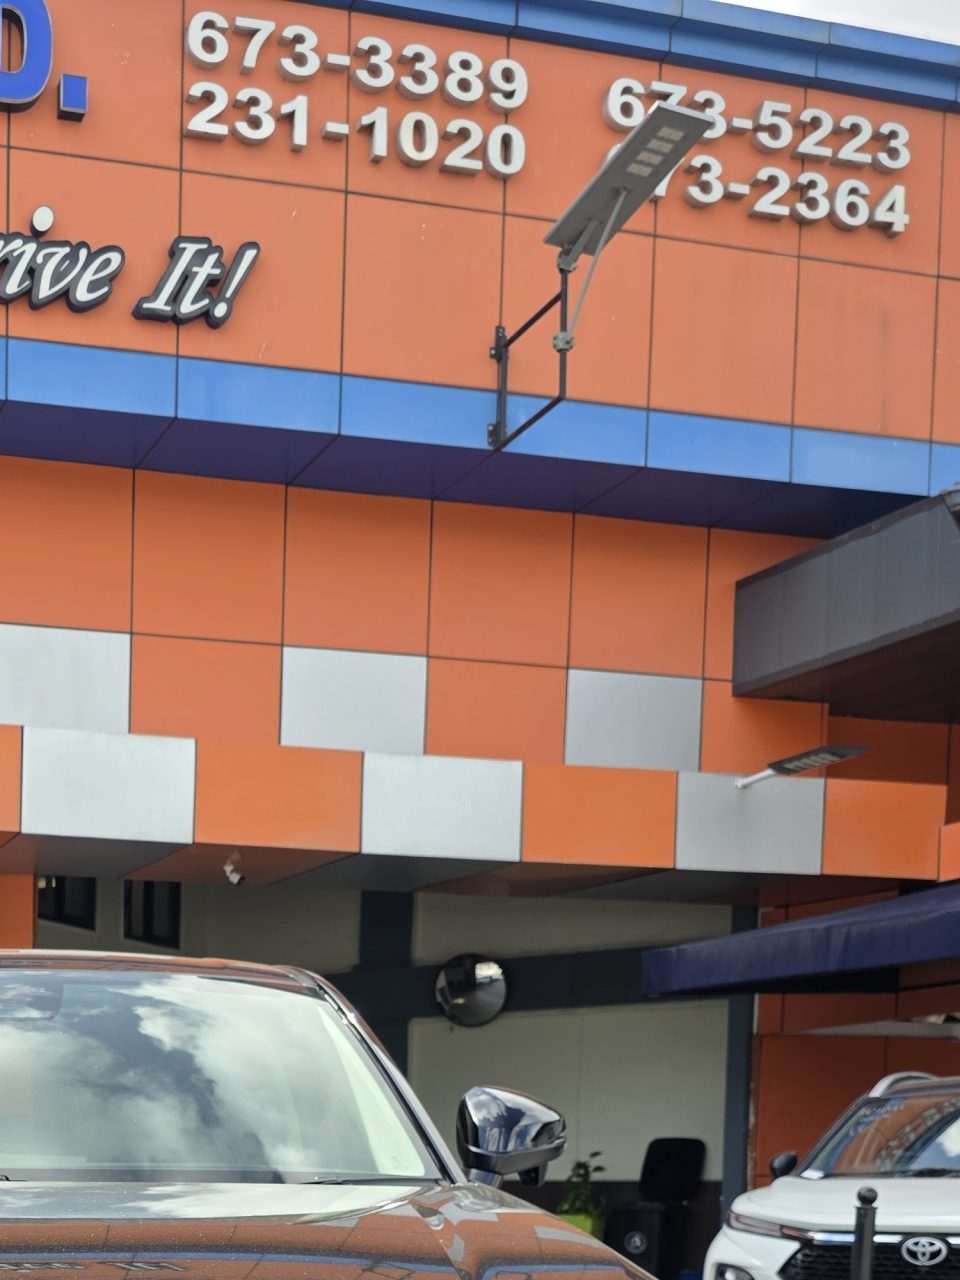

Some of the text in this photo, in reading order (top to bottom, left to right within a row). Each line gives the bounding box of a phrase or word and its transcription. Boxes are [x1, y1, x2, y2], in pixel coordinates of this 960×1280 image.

[187, 11, 528, 110] 673-3389
[187, 81, 526, 176] 231-1020
[601, 143, 909, 234] 3-2364
[134, 236, 259, 327] It!
